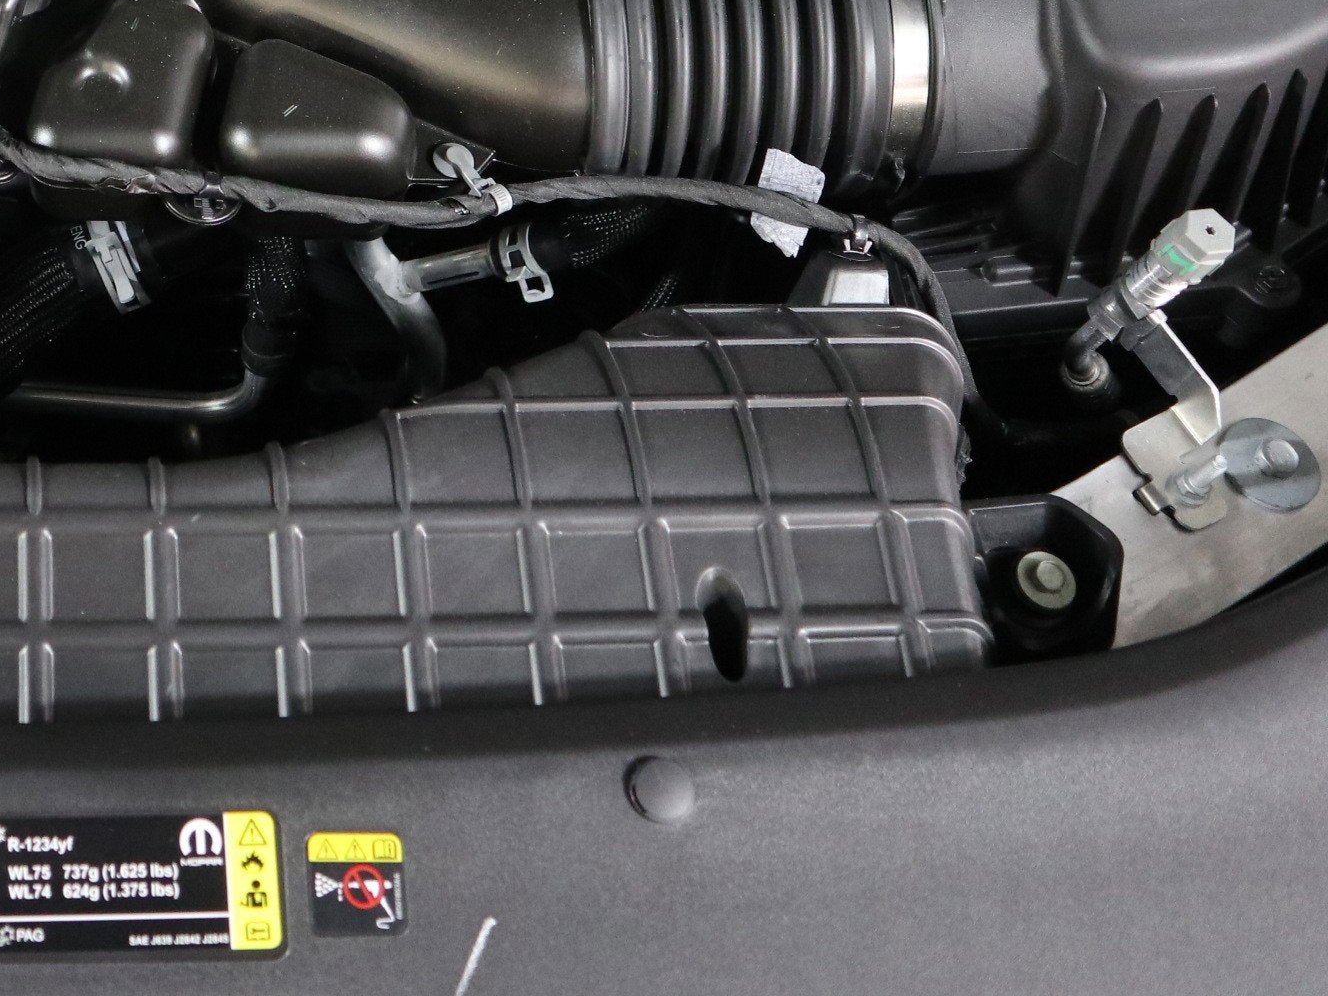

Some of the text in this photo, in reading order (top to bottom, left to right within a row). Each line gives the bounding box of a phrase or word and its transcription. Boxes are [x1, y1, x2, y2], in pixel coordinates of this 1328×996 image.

[70, 224, 88, 251] ENG
[7, 835, 74, 855] R-1234yf
[7, 862, 179, 883] WL75 737g (1.625 lbs)
[7, 881, 180, 902] WL74 624g (1.375 lbs)
[15, 927, 45, 943] PAG
[128, 934, 150, 947] SAE
